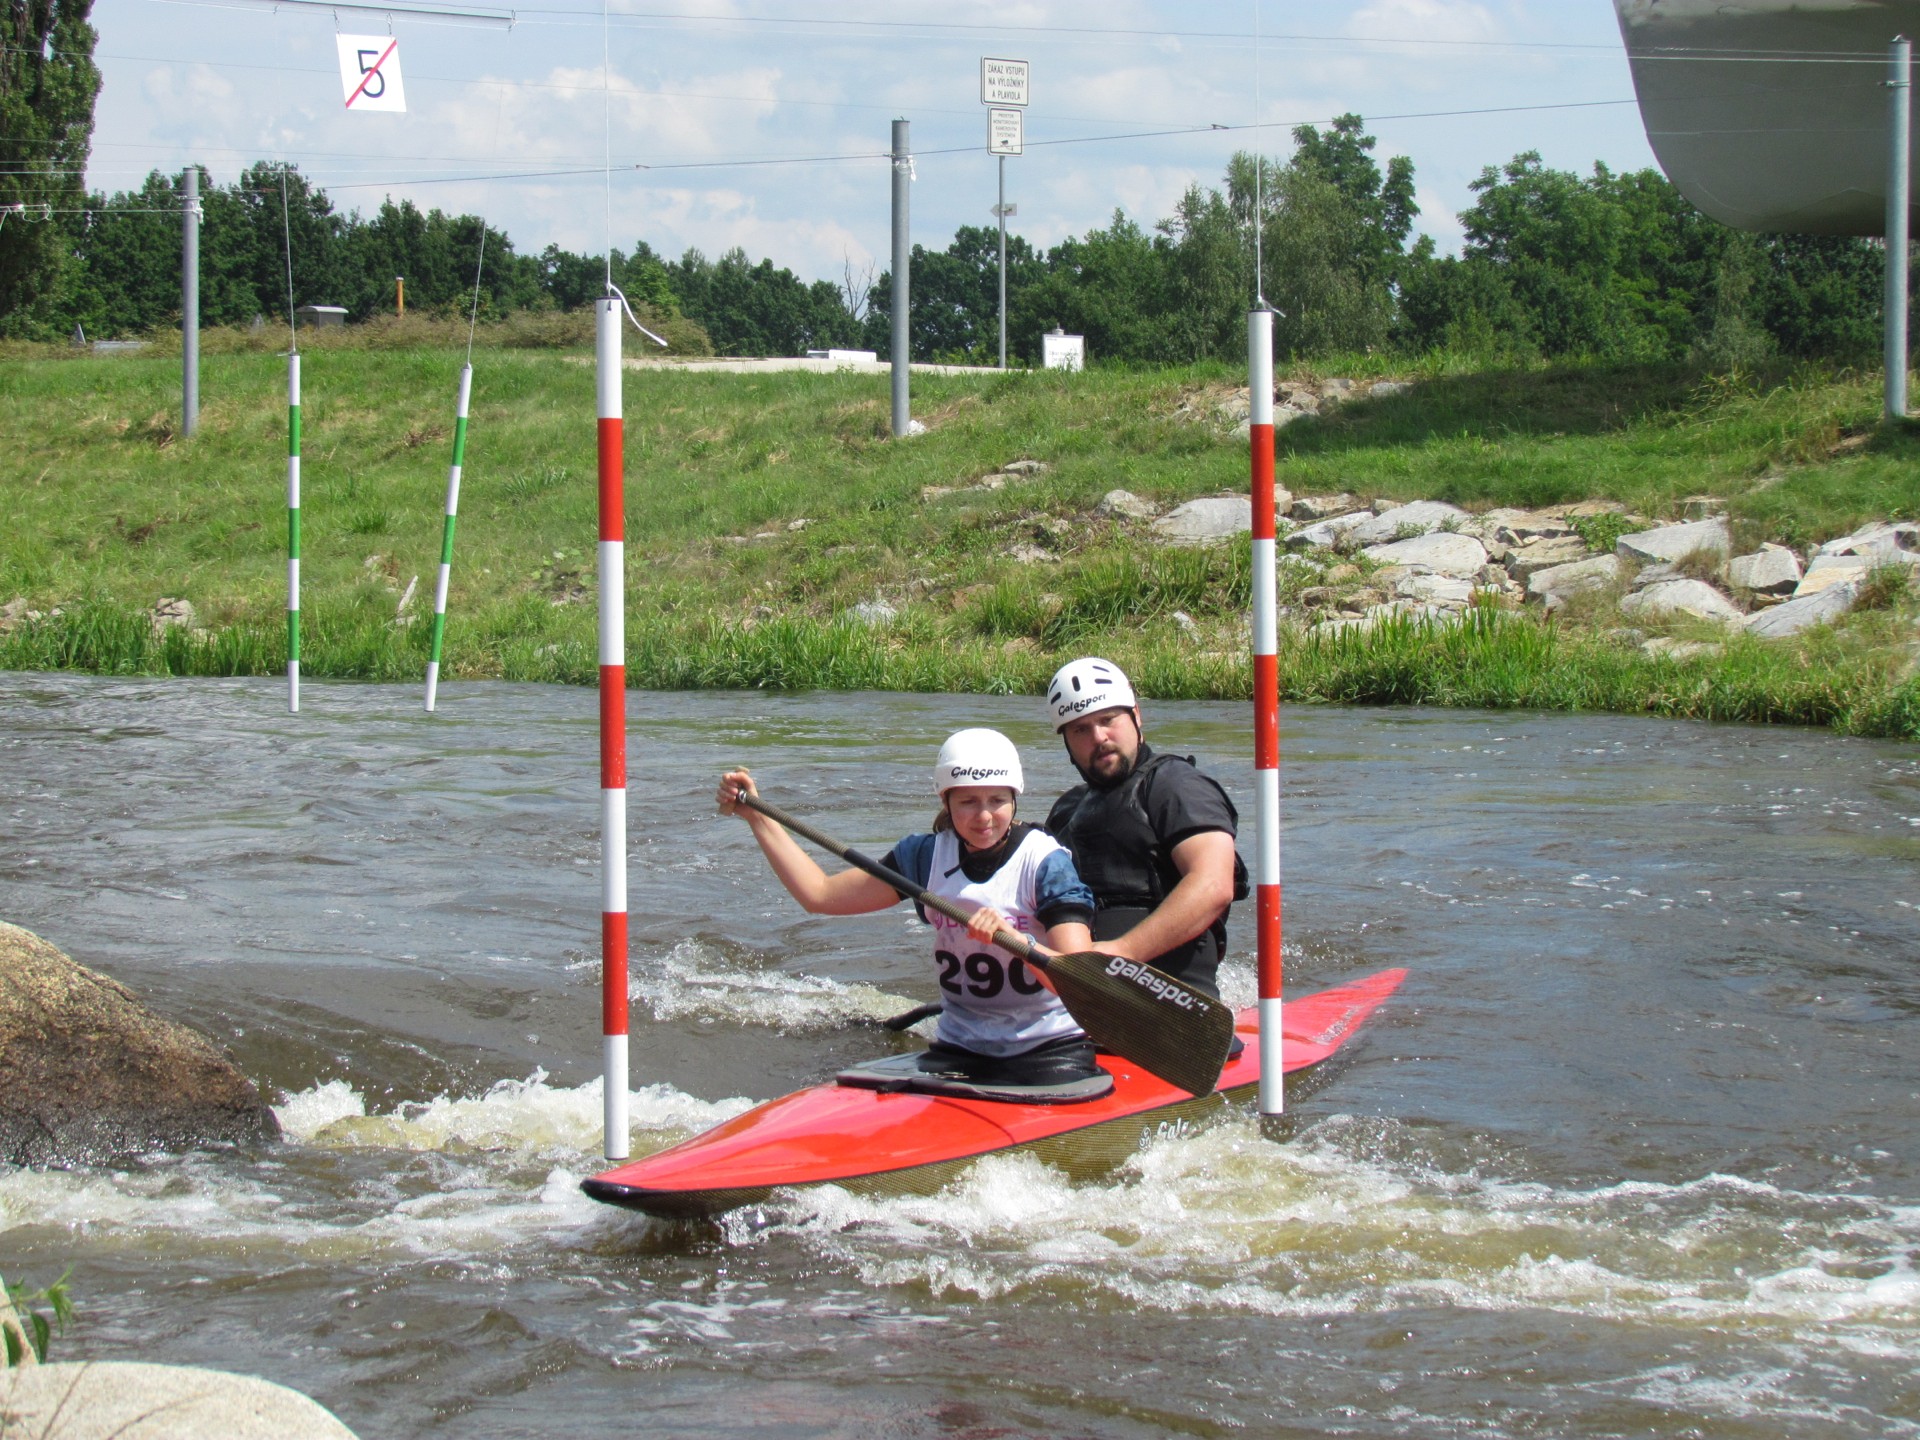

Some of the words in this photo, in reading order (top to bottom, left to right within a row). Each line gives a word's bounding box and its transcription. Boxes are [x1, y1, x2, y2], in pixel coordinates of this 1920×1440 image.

[357, 49, 385, 98] 5
[1005, 66, 1025, 76] VSTUPU
[988, 77, 996, 86] NA
[997, 90, 1021, 100] PLAVIDLA
